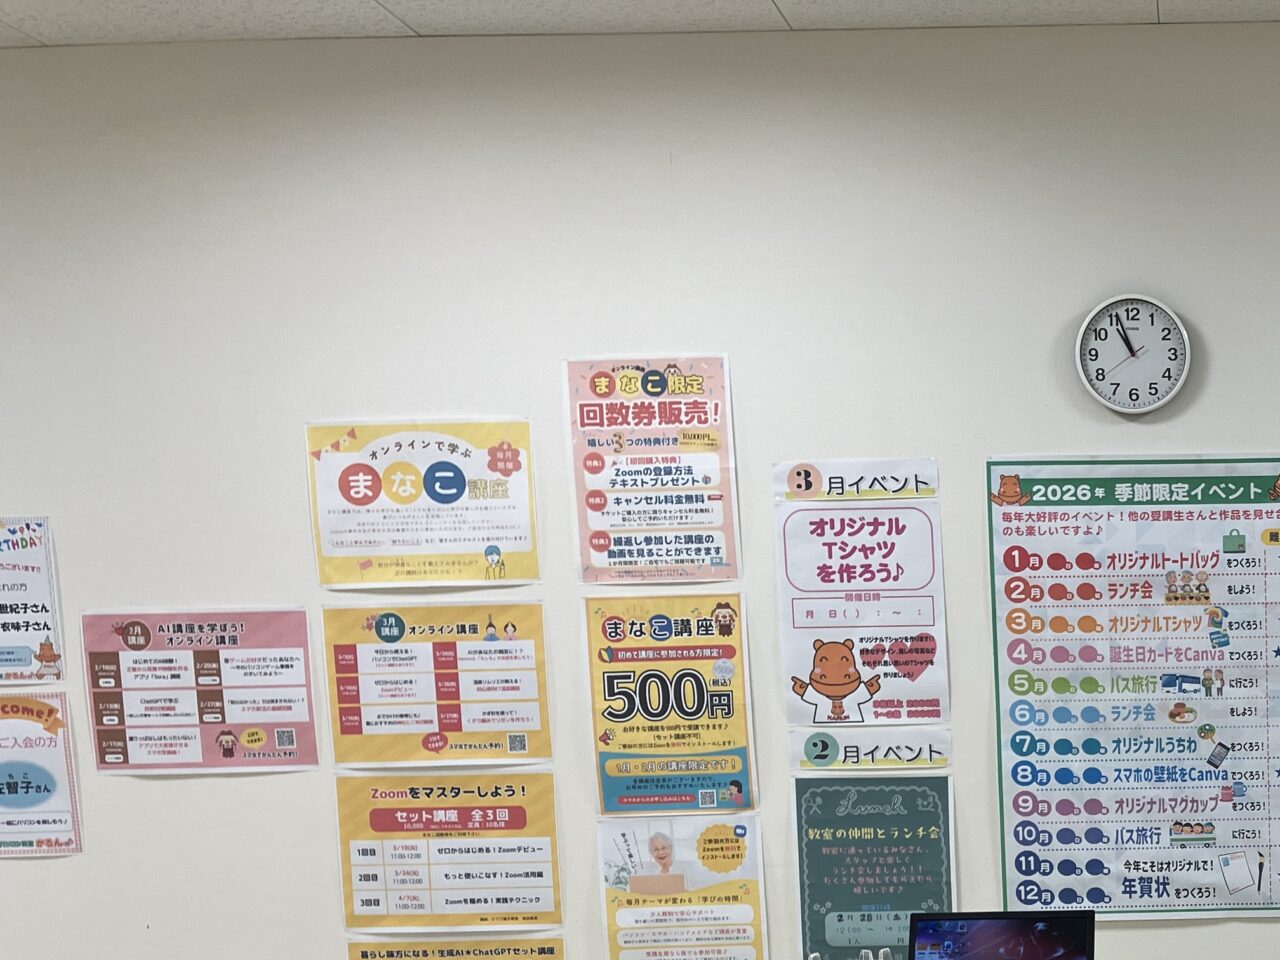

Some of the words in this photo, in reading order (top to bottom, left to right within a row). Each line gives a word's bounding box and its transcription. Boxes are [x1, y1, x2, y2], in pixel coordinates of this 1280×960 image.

[1125, 308, 1140, 321] 12
[1149, 313, 1154, 326] 1
[1093, 328, 1108, 341] 10
[1161, 328, 1171, 340] 2
[1089, 348, 1098, 361] 9
[1168, 348, 1178, 361] 3
[1095, 368, 1105, 381] 8
[1162, 368, 1172, 381] 4
[594, 375, 704, 394] まなこ限定
[1110, 383, 1120, 396] 7
[1149, 383, 1158, 396] 5
[1129, 388, 1139, 401] 6
[369, 439, 473, 460] オンラインで学ぶ
[614, 466, 693, 477] Zoomの登録方法
[348, 471, 509, 500] まなこ講座
[609, 476, 700, 488] テキストプレゼント
[796, 468, 930, 496] 3月イベント
[1031, 485, 1105, 502] 2026年
[1114, 482, 1262, 502] 季節限定イベント
[613, 494, 705, 506] キャンセル料金無料
[809, 516, 907, 537] オリジナル
[613, 534, 714, 546] 繰返し参加した講座の
[607, 545, 722, 558] 動画を見ることができます
[822, 541, 896, 560] Tシャツ
[1106, 551, 1220, 570] オリジナルトートバッグ
[1009, 581, 1040, 599] 2月
[1107, 580, 1153, 599] ランチ会
[805, 609, 814, 619] 月
[408, 623, 479, 636] オンライン講座
[606, 618, 715, 637] まなこ講座
[1011, 612, 1042, 630] 3月
[1108, 613, 1202, 634] オリジナルTシャツ
[381, 627, 399, 636] 講座
[166, 635, 239, 646] オンライン講座
[1011, 643, 1043, 661] 4月
[1110, 645, 1225, 664] 誕生日カードをCanva
[1014, 673, 1044, 692] 5月
[1110, 674, 1158, 694] バス旅行
[602, 669, 733, 722] 500円
[1015, 704, 1046, 722] 6月
[1111, 703, 1156, 722] ランチ会
[813, 739, 944, 764] 2月イベント
[1015, 735, 1046, 752] 7月
[1111, 736, 1198, 755] オリジナルうちわ
[1017, 765, 1047, 782] 8月
[1113, 767, 1229, 783] スマホの壁紙をCanva
[371, 785, 526, 800] Zoomをマスターしよう！
[836, 791, 908, 816] Lunch
[1017, 795, 1048, 813] 9月
[1114, 794, 1220, 815] オリジナルマグカップ
[395, 809, 459, 822] セット講座
[808, 825, 940, 840] 教室の仲間とランチ会
[1016, 826, 1049, 843] 10月
[1114, 826, 1162, 845] バス旅行
[1018, 884, 1052, 903] 12月
[1121, 877, 1170, 899] 年賀状
